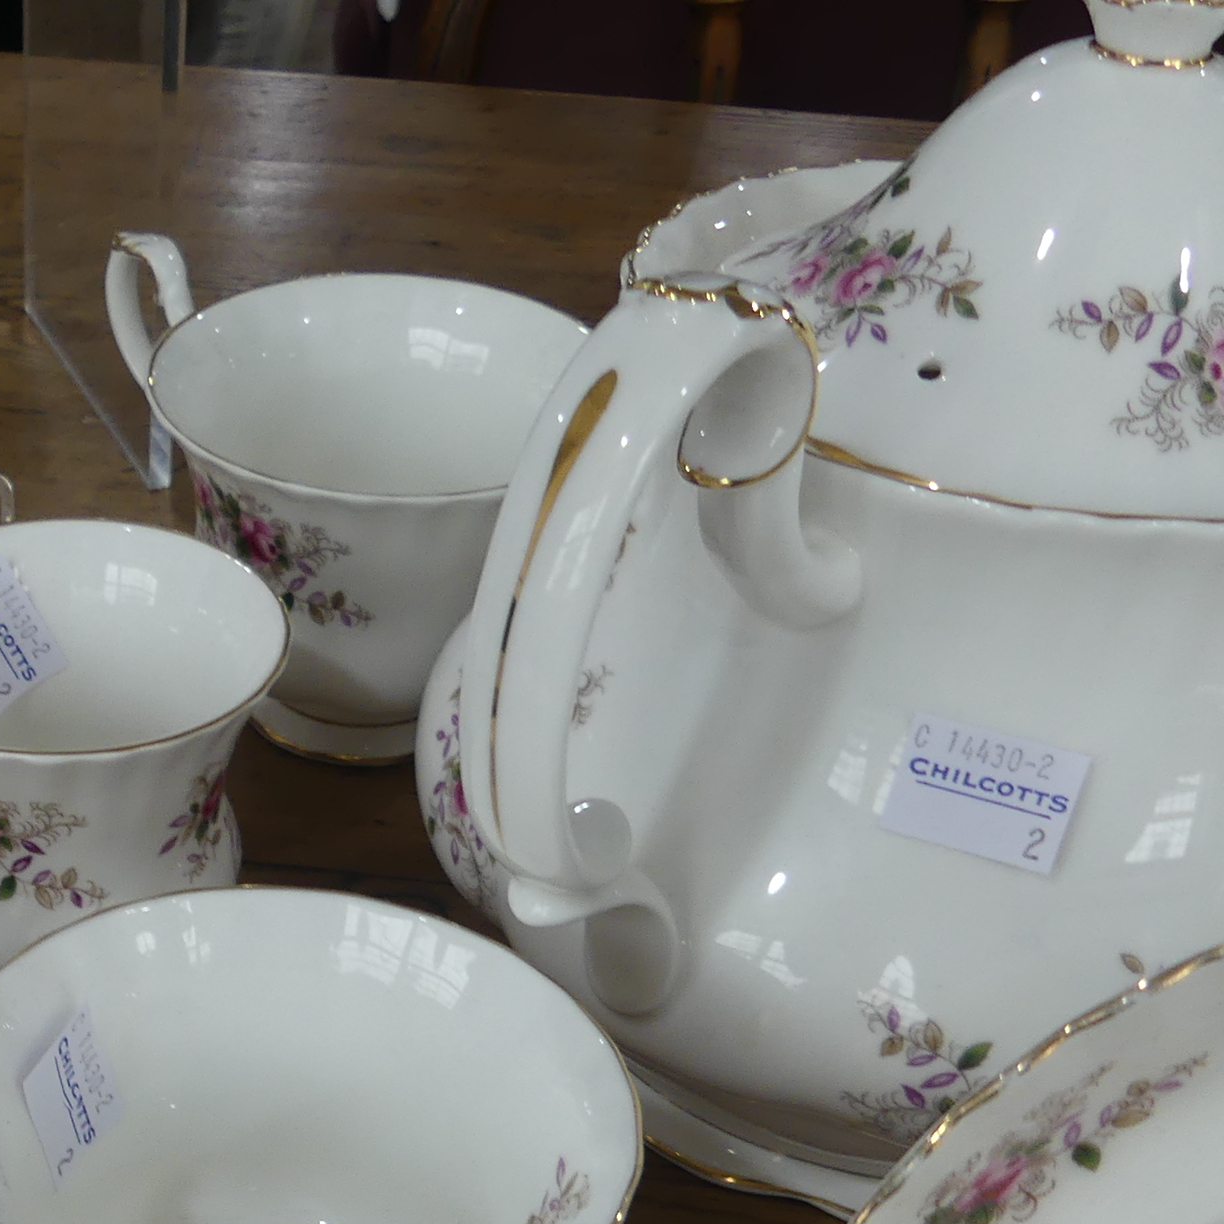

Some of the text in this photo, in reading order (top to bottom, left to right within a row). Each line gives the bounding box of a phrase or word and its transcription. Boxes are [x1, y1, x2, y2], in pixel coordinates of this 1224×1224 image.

[947, 729, 1055, 781] 14430-2
[908, 756, 1070, 814] CHILCOTTS
[1021, 827, 1046, 861] 2
[56, 1147, 75, 1177] 2
